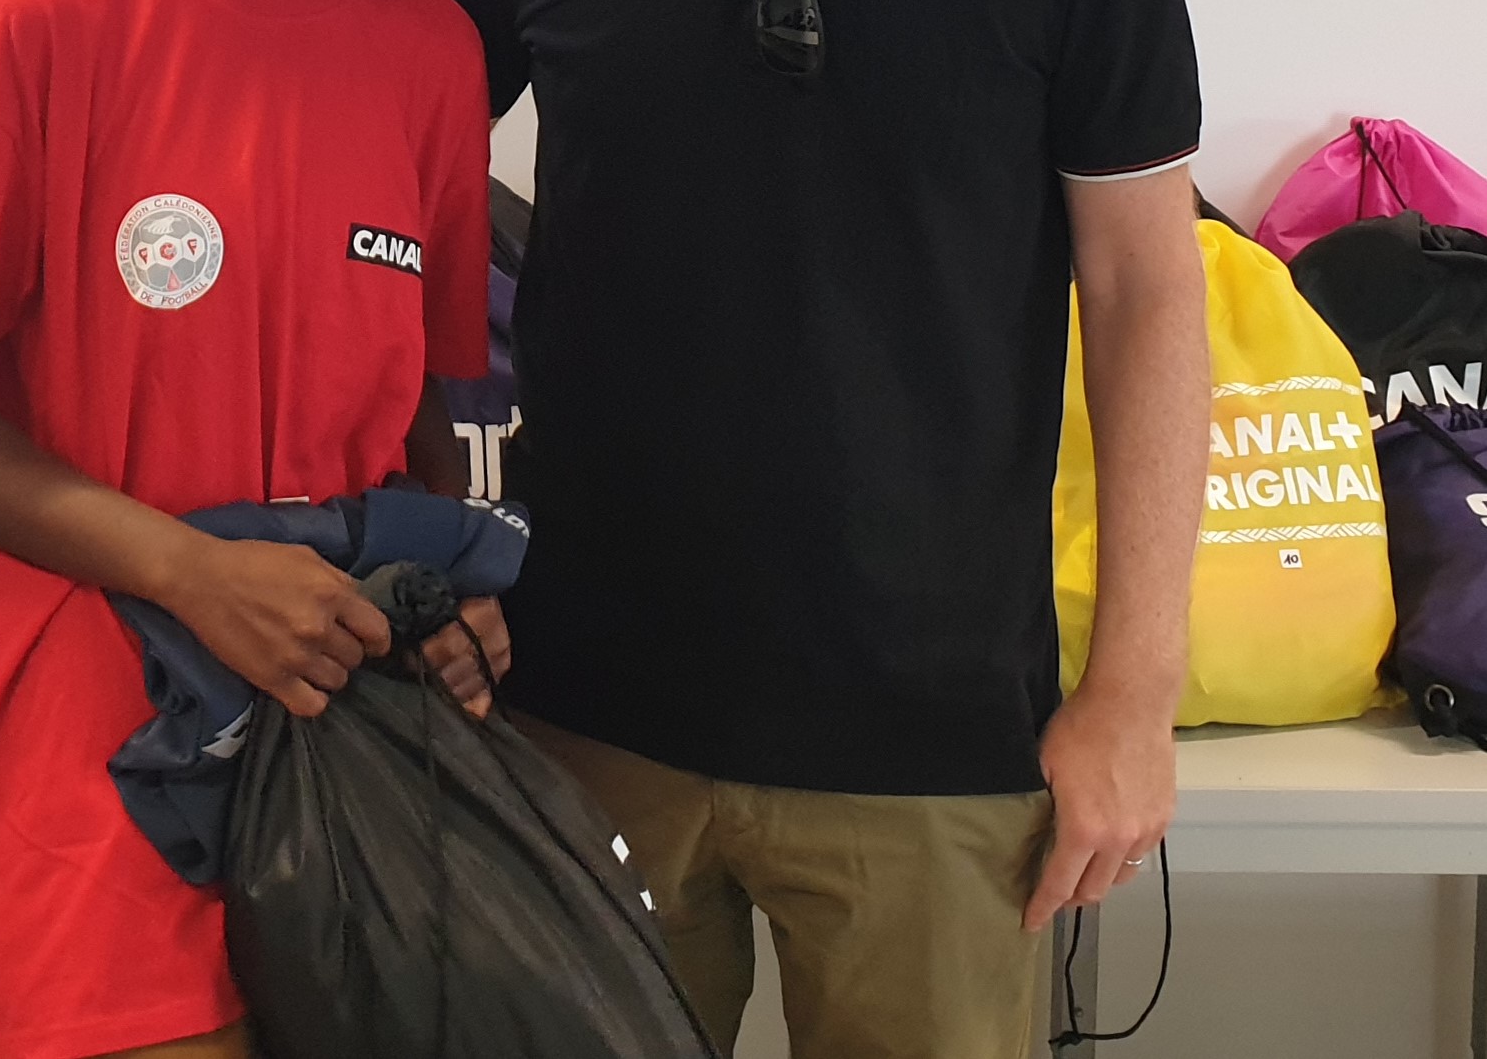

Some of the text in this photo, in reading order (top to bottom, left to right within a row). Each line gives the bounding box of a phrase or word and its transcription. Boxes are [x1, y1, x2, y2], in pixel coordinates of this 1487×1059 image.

[140, 291, 154, 303] DE
[1209, 411, 1363, 458] ANAL+
[1206, 464, 1381, 511] RIGINAL
[1284, 553, 1299, 565] 10
